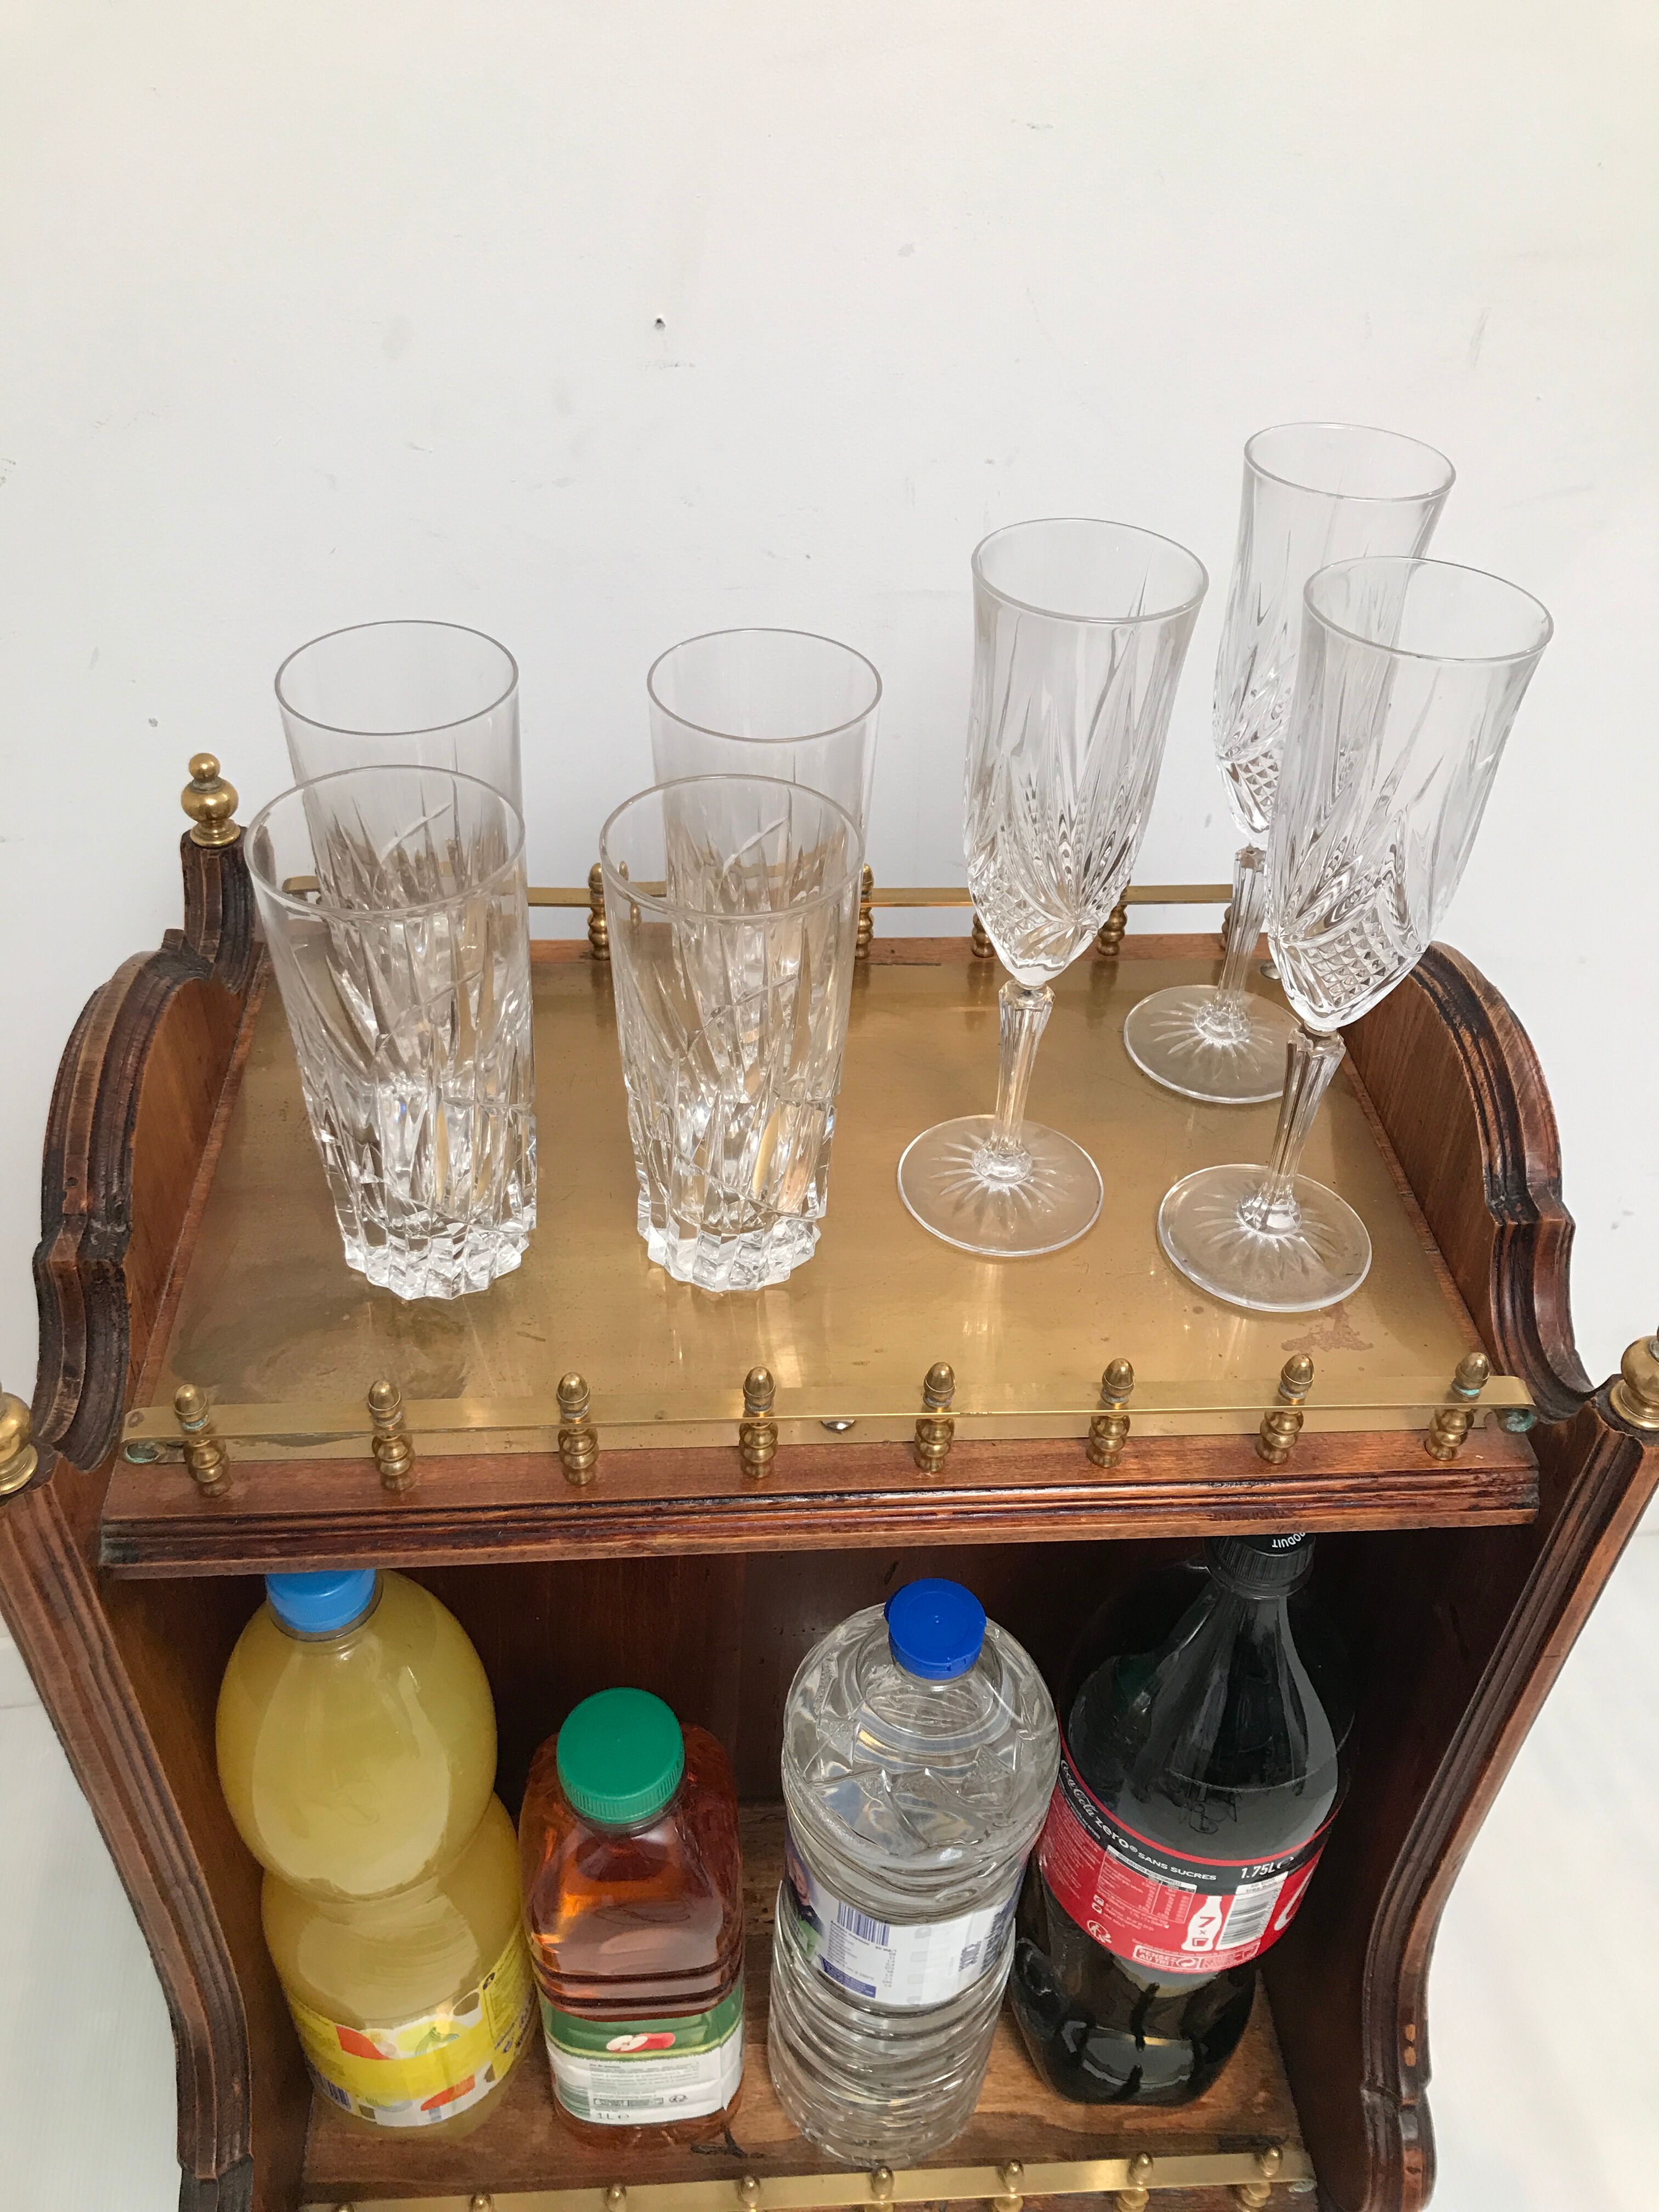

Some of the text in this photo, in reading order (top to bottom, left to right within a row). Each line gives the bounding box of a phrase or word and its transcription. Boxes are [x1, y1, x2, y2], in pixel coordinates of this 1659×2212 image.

[1138, 1852, 1168, 1870] SANS
[1170, 1866, 1217, 1880] SUCRES
[1241, 1862, 1276, 1878] 1.75L
[1199, 1916, 1216, 1928] 7
[1138, 1954, 1153, 1962] AU
[1139, 1949, 1178, 1962] PENSEZ
